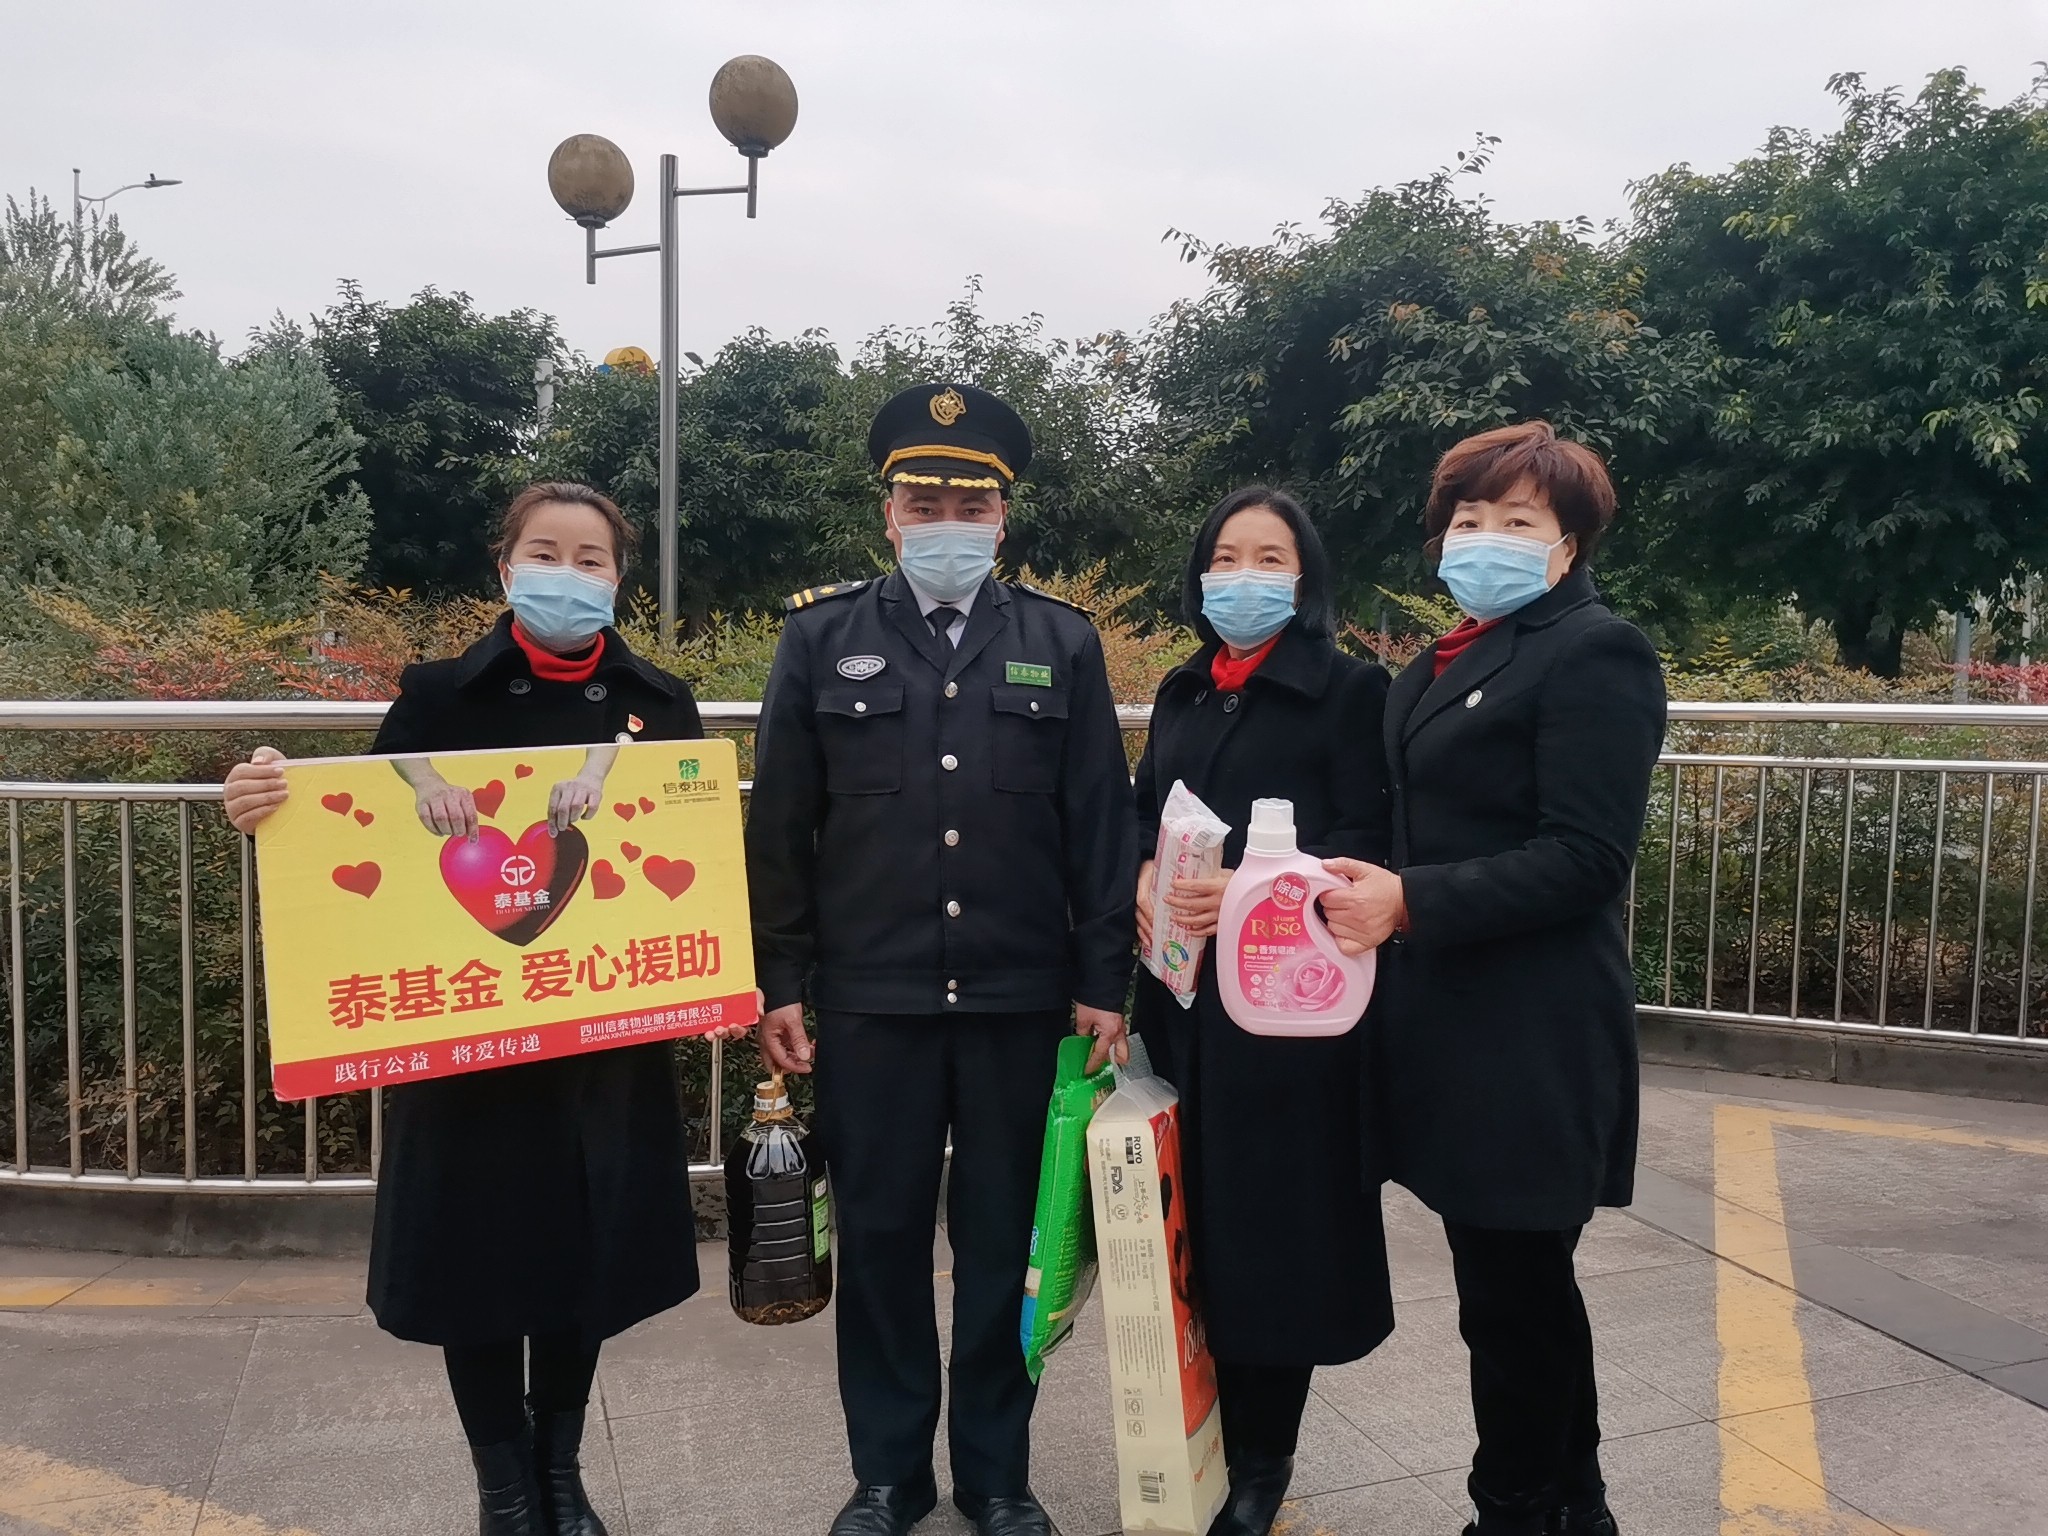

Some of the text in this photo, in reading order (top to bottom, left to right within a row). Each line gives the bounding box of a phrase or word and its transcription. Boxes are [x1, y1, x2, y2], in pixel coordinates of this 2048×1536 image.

[663, 779, 720, 794] 信泰物业
[494, 889, 551, 909] 泰基金
[1274, 880, 1306, 902] 除菌
[1251, 919, 1302, 938] Rose
[327, 929, 721, 1030] 泰基金 爱心援助
[580, 1003, 723, 1037] 四川信泰物业服务有限公司
[580, 1033, 611, 1044] SICHUAN
[611, 1030, 631, 1039] XINTAI
[632, 1025, 667, 1035] PROPERTY
[667, 1019, 698, 1030] SERVICES
[335, 1033, 541, 1083] 践行公益 将爱传递
[1133, 1136, 1143, 1164] ROYO
[1111, 1166, 1123, 1194] FDA
